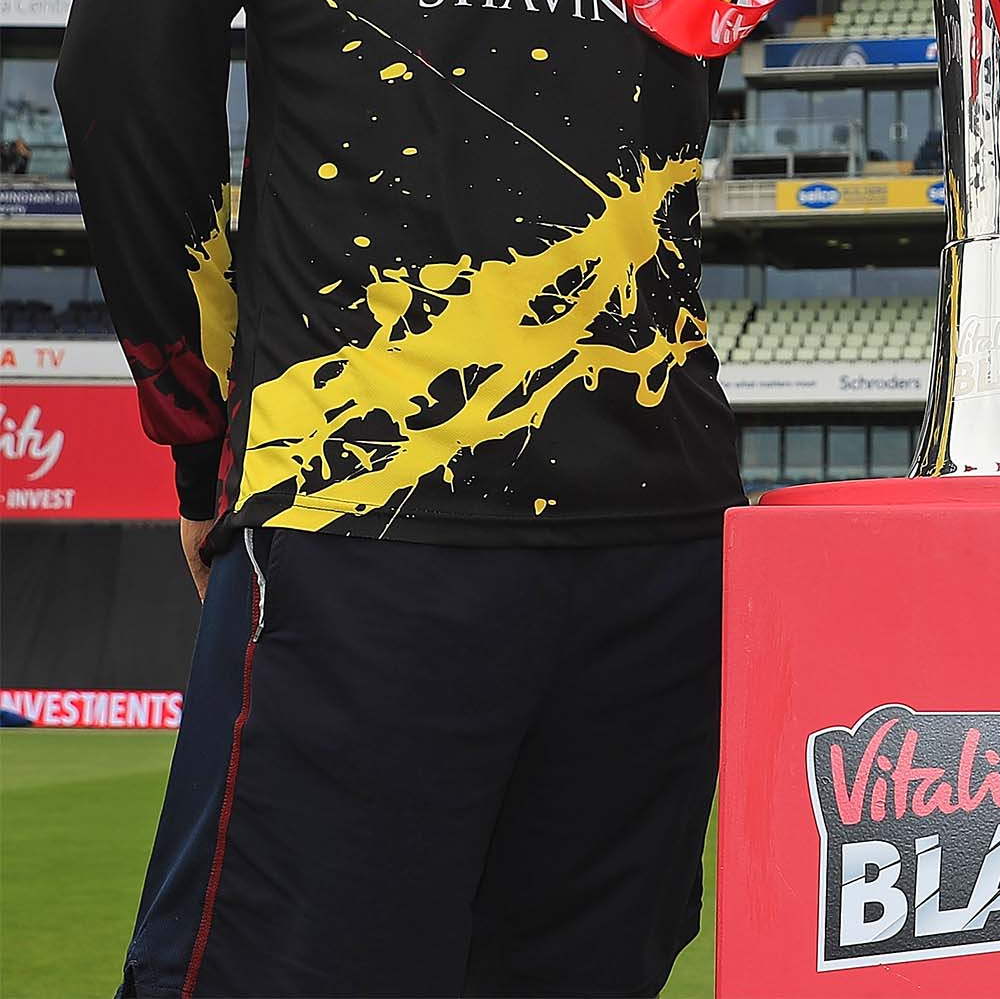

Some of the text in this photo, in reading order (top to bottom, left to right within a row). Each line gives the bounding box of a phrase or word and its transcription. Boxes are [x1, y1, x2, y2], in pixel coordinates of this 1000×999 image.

[35, 348, 66, 368] TV
[839, 374, 921, 390] Schroders
[0, 402, 65, 482] ity
[7, 488, 76, 510] INVEST
